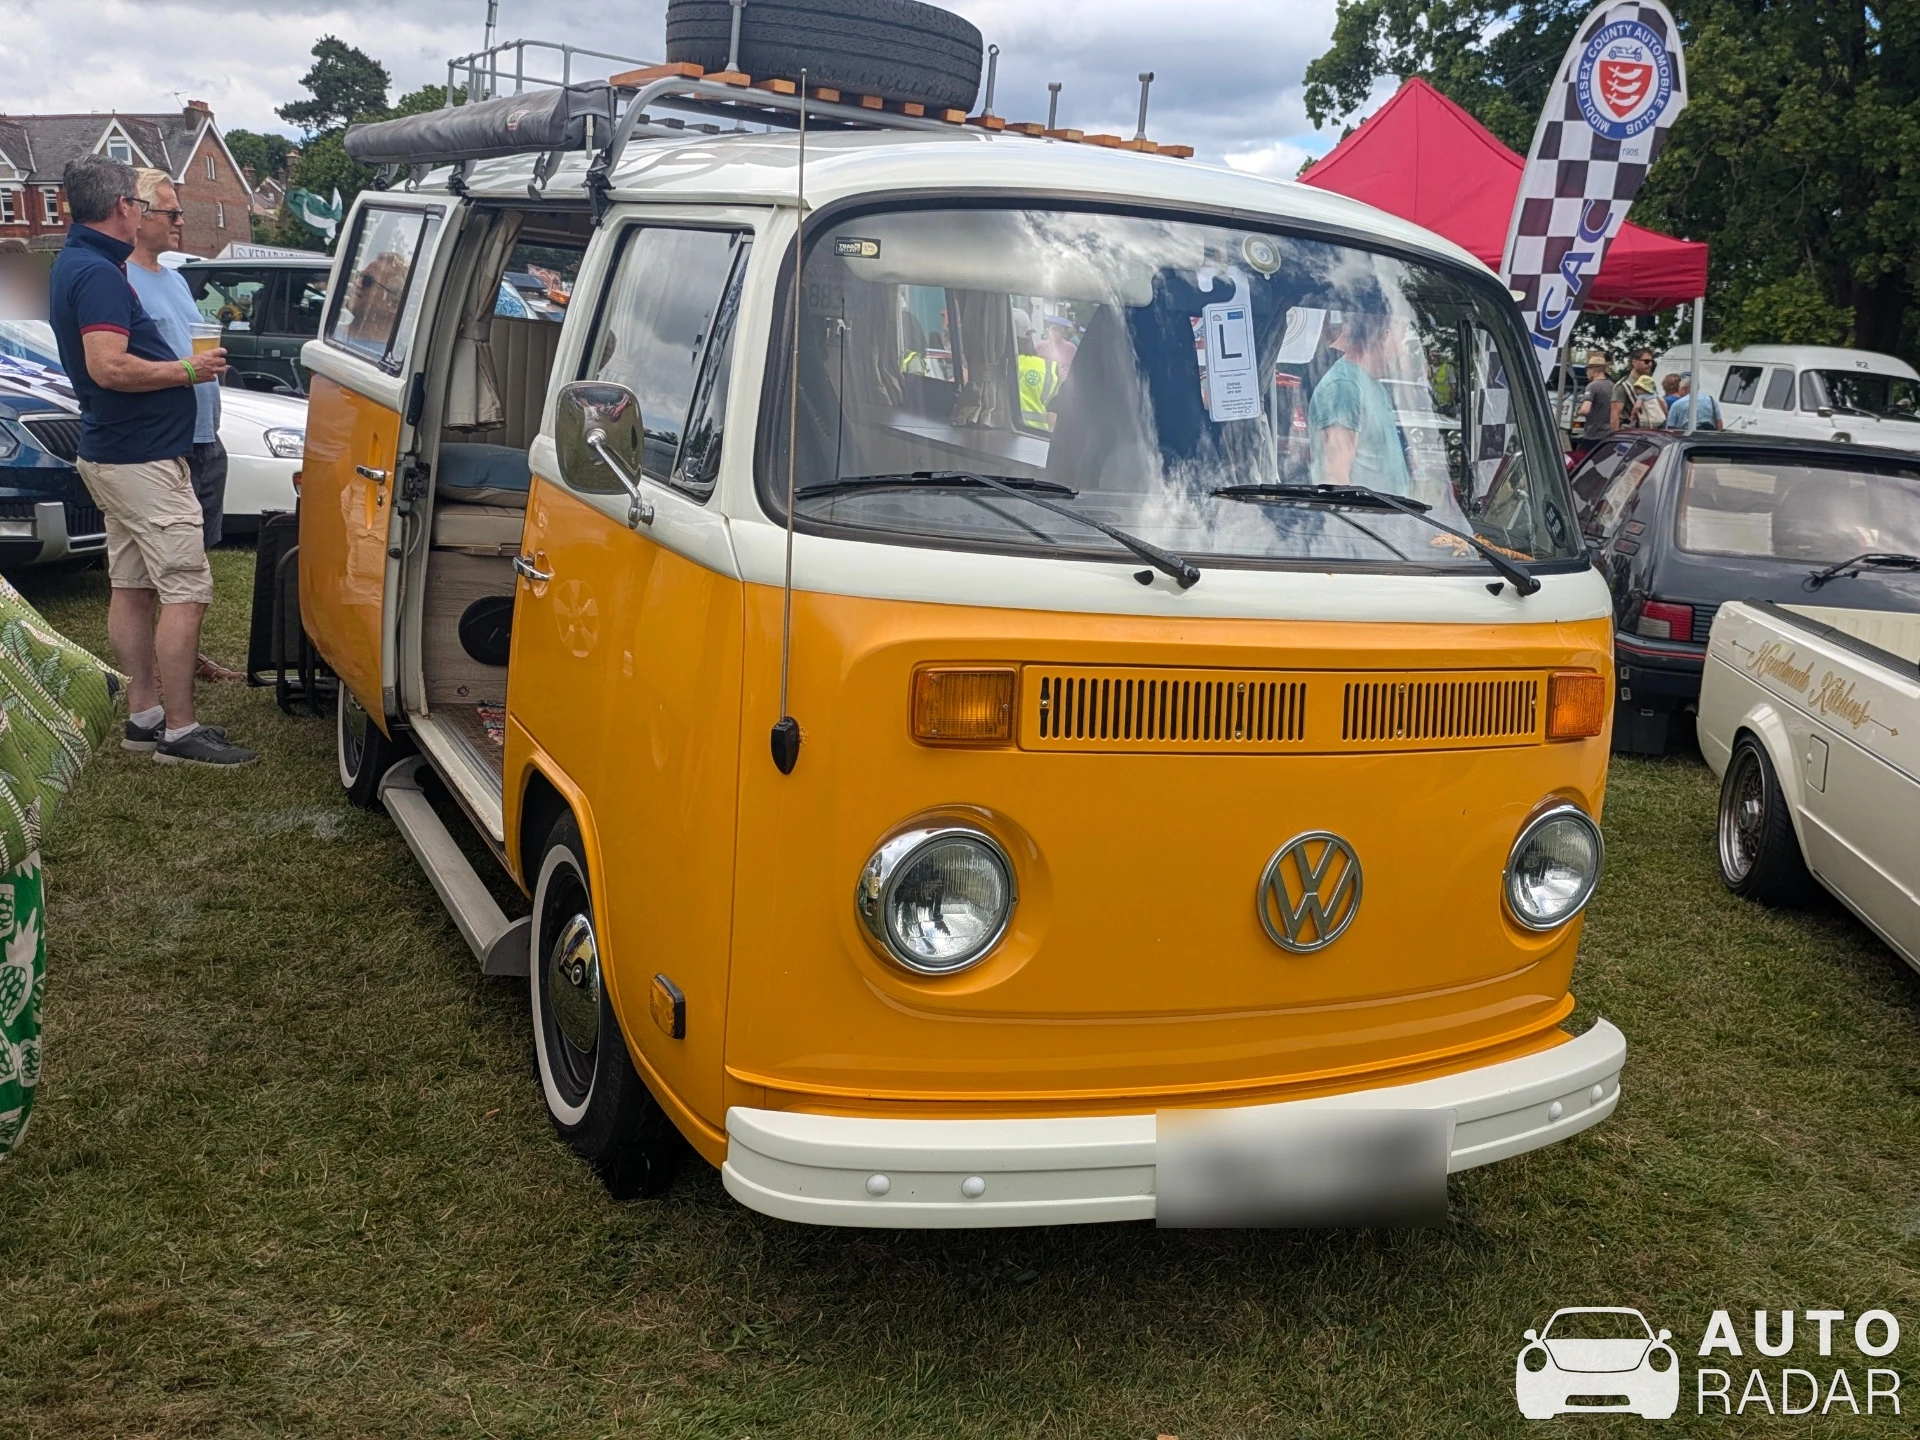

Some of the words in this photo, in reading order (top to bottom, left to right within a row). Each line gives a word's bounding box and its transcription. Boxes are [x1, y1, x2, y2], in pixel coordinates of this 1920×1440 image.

[1587, 24, 1632, 58] COUNTY
[1633, 26, 1669, 109] AUTOMOBILE
[1580, 62, 1610, 133] MIDDLESEX
[1625, 109, 1656, 135] CLUB
[1219, 324, 1242, 359] L
[1747, 640, 1814, 694] Handmade
